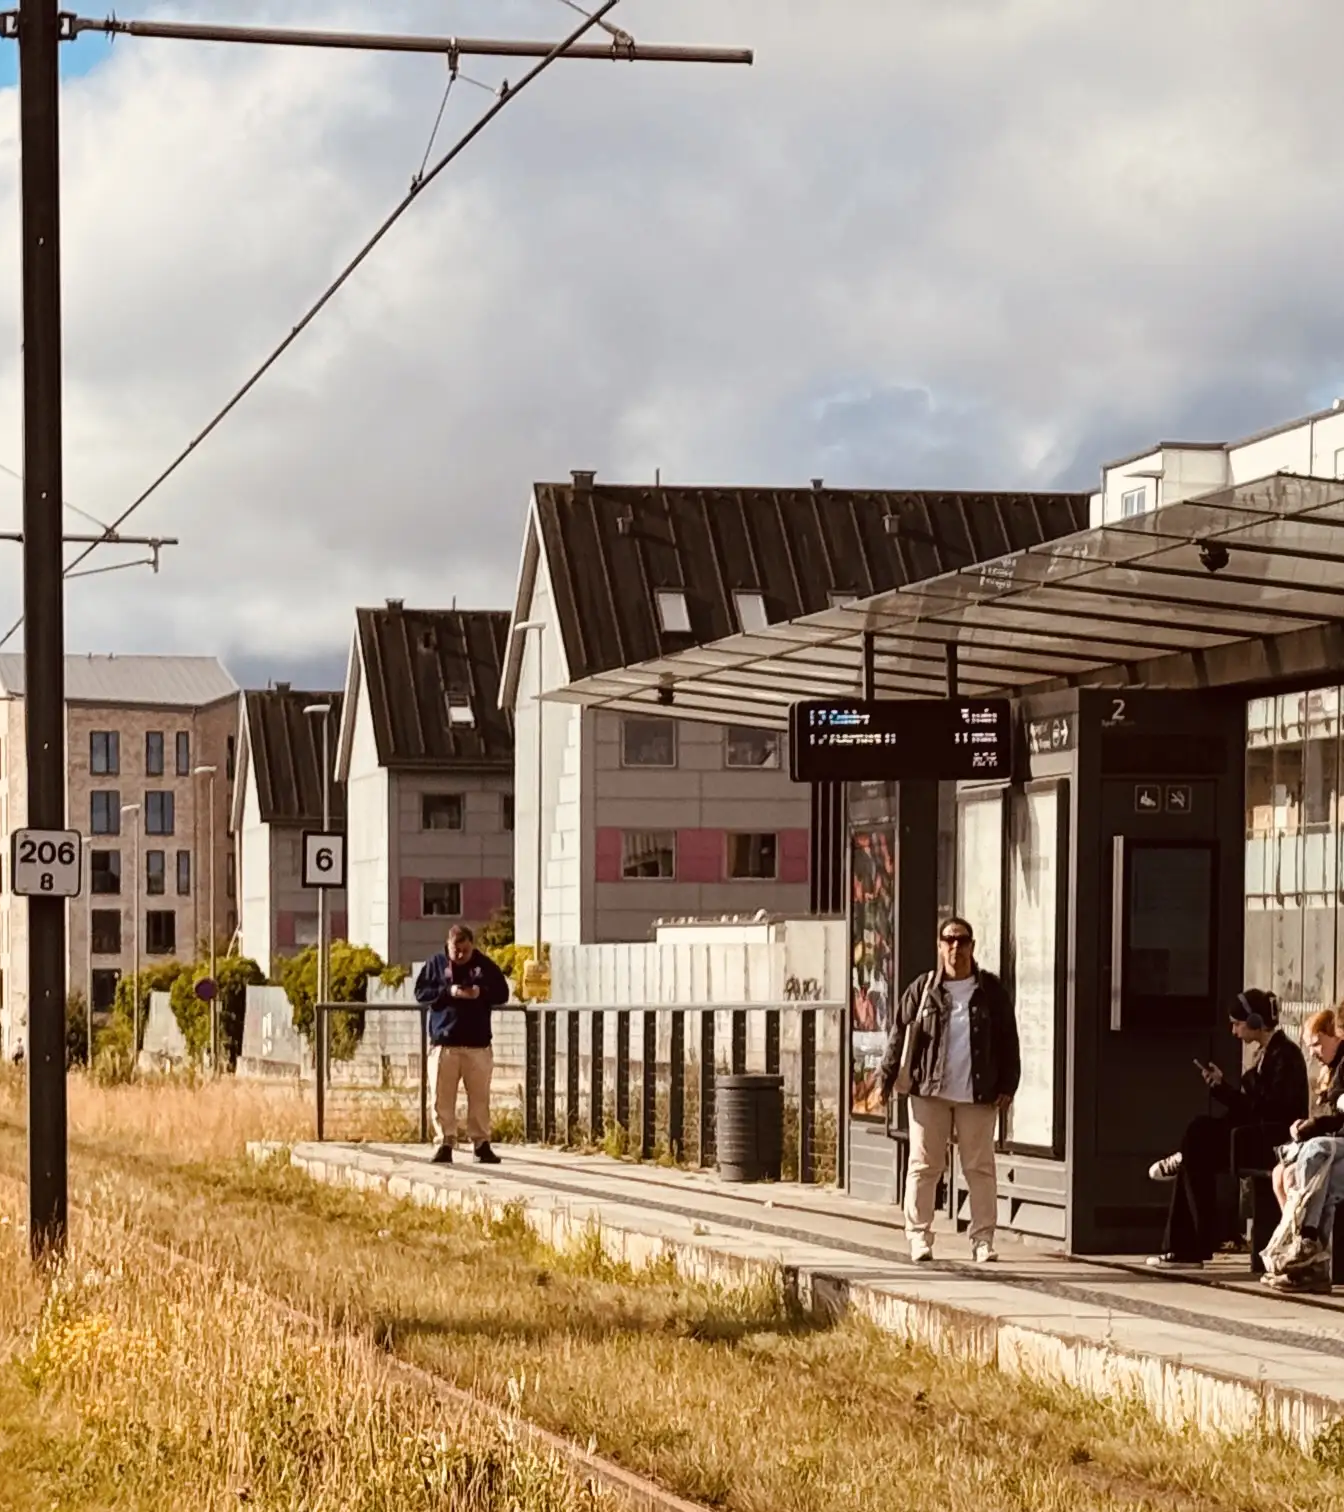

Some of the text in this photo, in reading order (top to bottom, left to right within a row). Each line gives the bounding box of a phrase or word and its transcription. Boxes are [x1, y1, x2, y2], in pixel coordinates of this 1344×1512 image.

[1111, 699, 1126, 720] 2
[19, 840, 76, 866] 206
[315, 848, 333, 872] 6
[39, 873, 54, 891] 8
